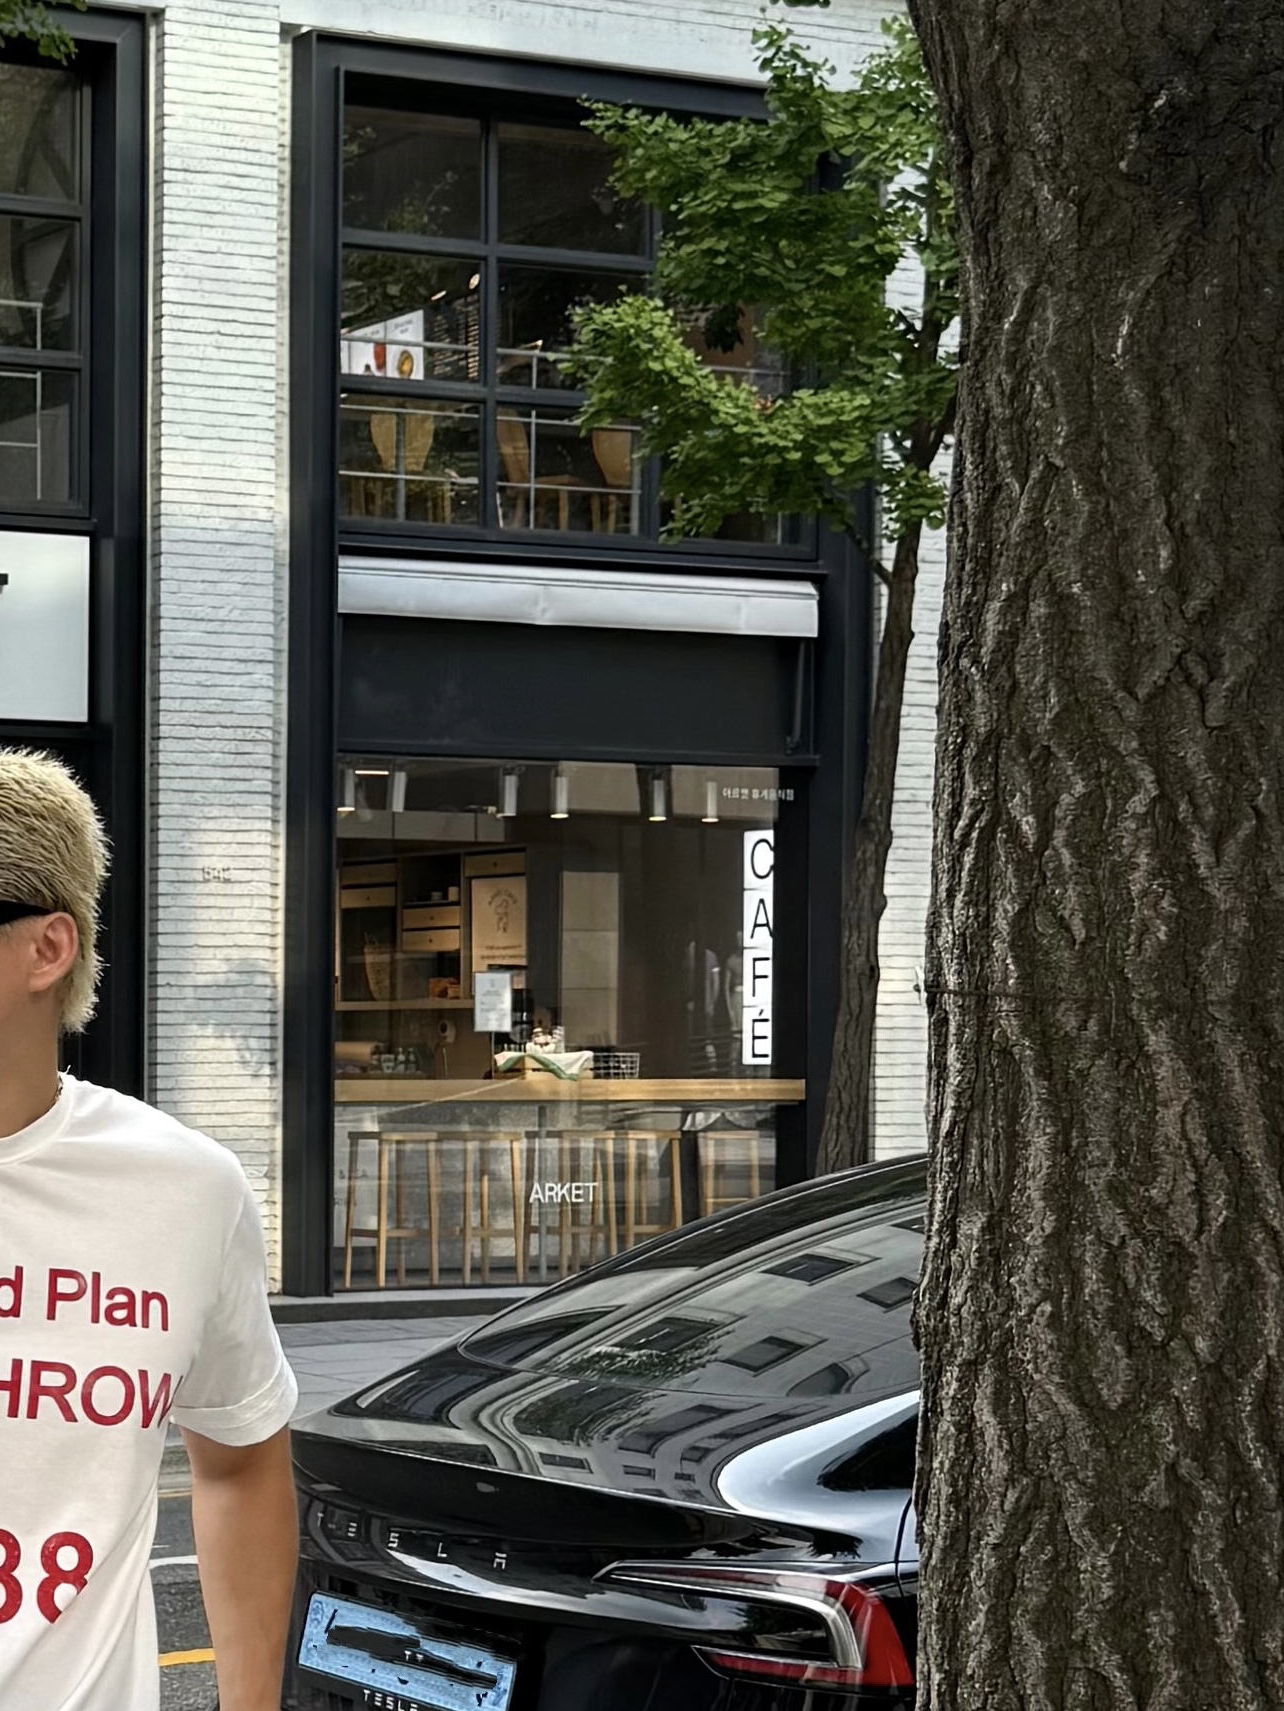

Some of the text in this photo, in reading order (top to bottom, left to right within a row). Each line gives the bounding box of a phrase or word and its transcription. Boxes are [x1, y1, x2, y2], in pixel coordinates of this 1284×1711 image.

[750, 838, 774, 1058] CAFÉ
[529, 1182, 599, 1204] ARKET
[46, 1268, 169, 1331] Plan
[317, 1512, 508, 1570] TESLA
